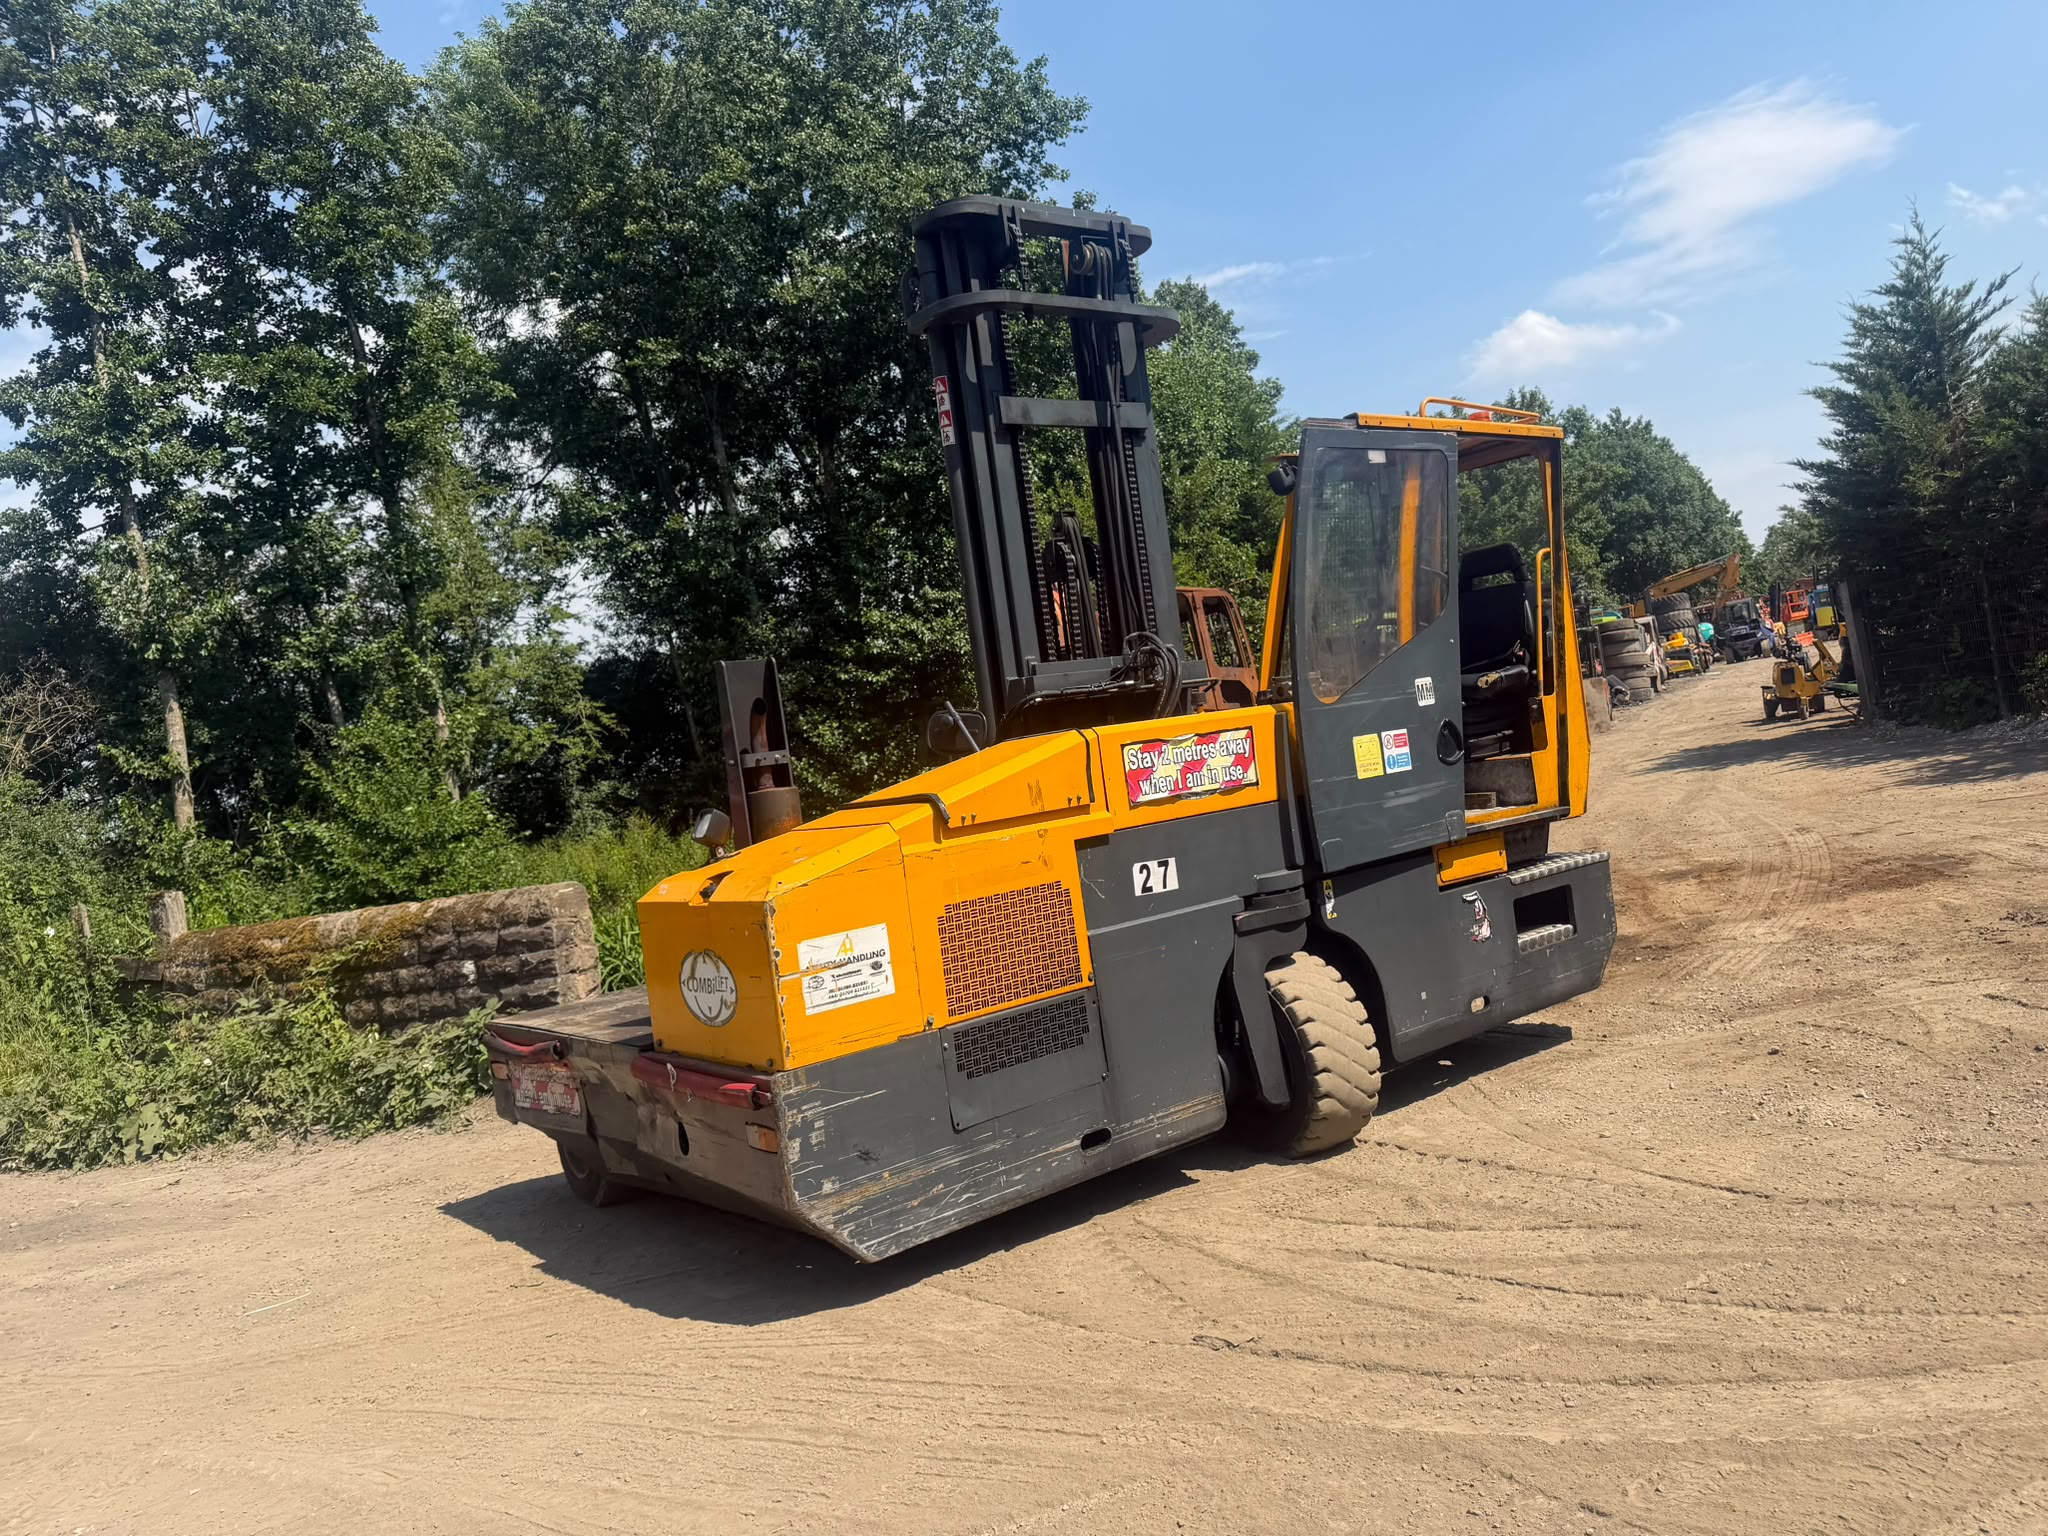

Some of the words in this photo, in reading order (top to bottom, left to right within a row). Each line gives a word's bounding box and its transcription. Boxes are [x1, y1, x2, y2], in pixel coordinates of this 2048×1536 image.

[1128, 747, 1159, 772] Stay
[1161, 745, 1171, 765] 2
[1173, 739, 1218, 763] metres
[1220, 736, 1250, 758] away
[1139, 770, 1175, 796] when
[1177, 769, 1183, 789] I
[1186, 770, 1206, 788] am
[1207, 764, 1220, 785] in
[1222, 765, 1248, 782] use.
[1139, 859, 1169, 894] 27
